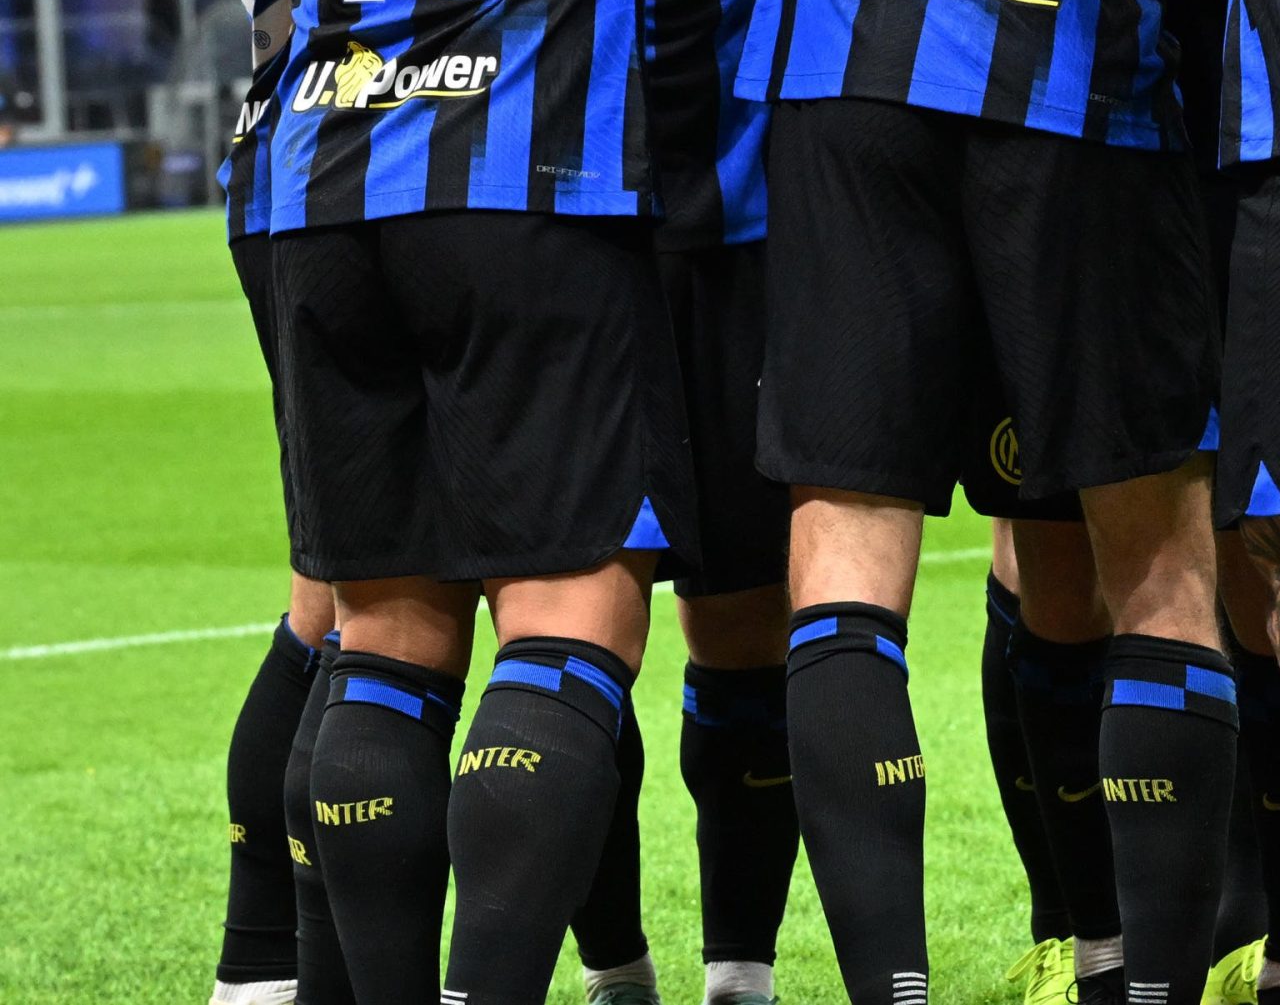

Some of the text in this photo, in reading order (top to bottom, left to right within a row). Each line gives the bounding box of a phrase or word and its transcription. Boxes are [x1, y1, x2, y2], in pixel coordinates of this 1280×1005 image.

[458, 746, 541, 776] INTER
[1102, 778, 1177, 802] INTER
[315, 797, 393, 826] INTER
